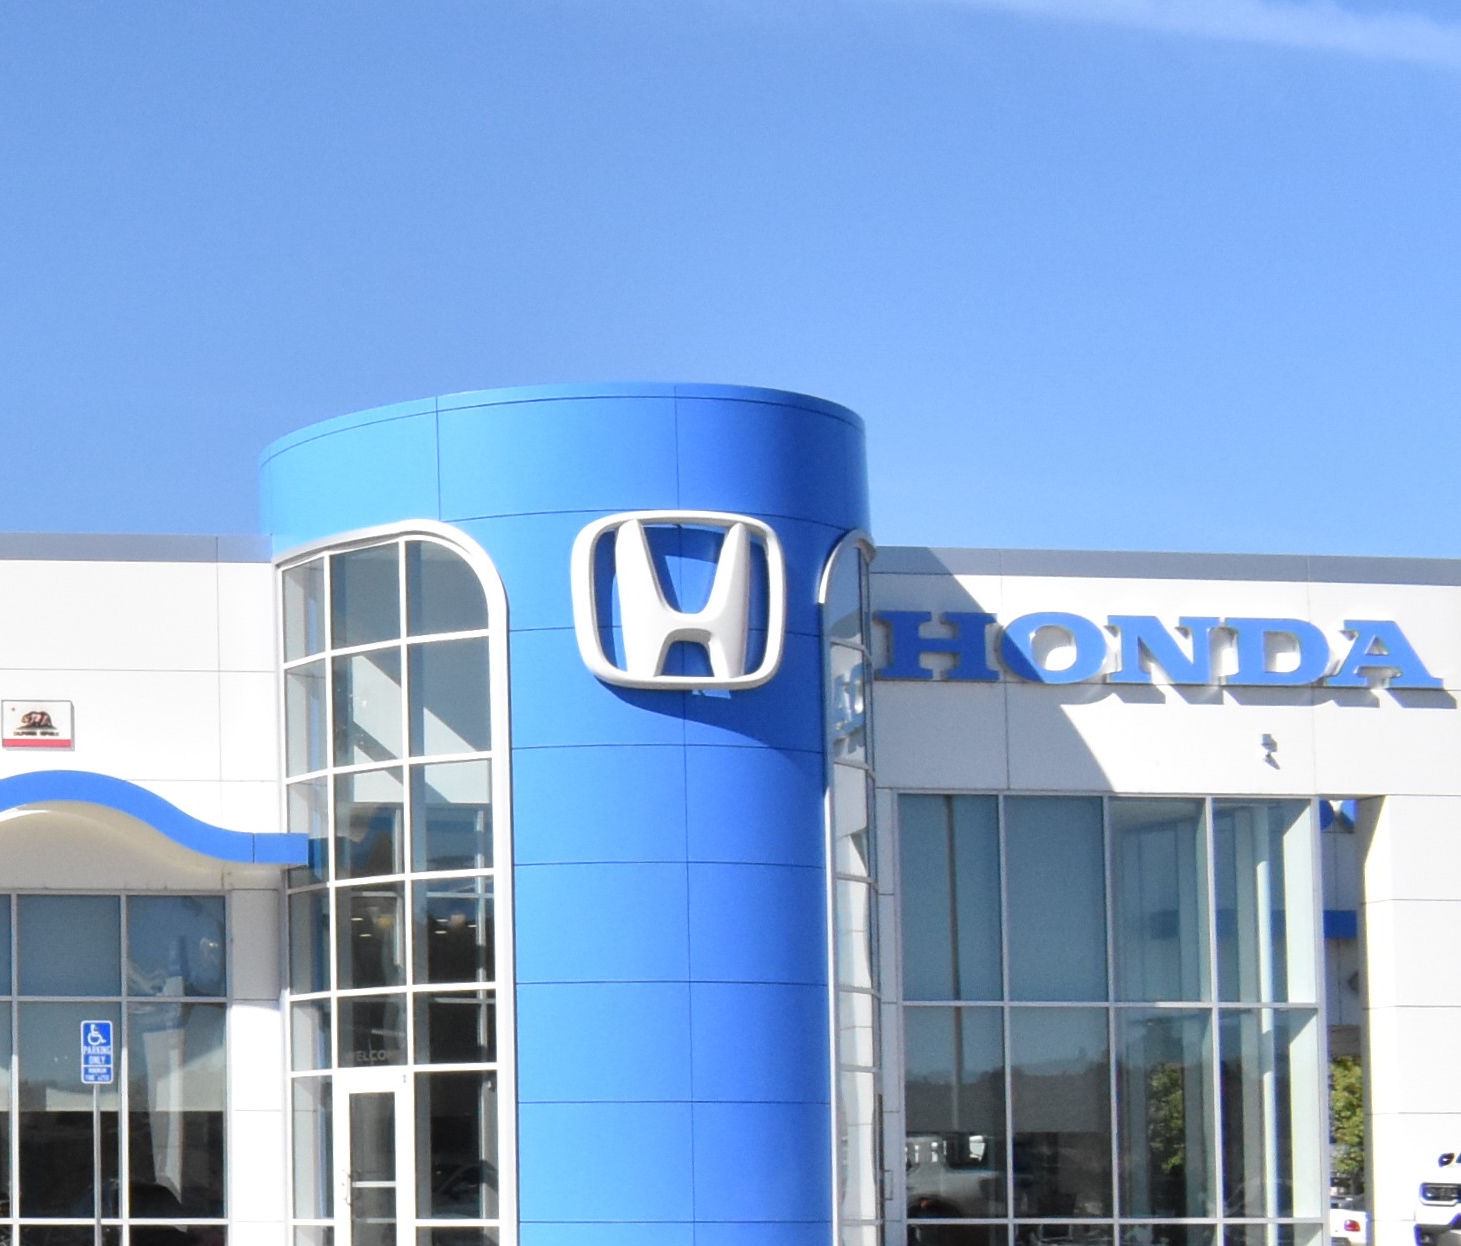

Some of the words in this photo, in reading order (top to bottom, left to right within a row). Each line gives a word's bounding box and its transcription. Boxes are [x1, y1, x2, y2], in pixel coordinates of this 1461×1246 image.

[877, 610, 1445, 689] HONDA
[83, 1046, 112, 1055] PARKING
[344, 1049, 402, 1062] ELCO
[88, 1056, 106, 1065] ONLY
